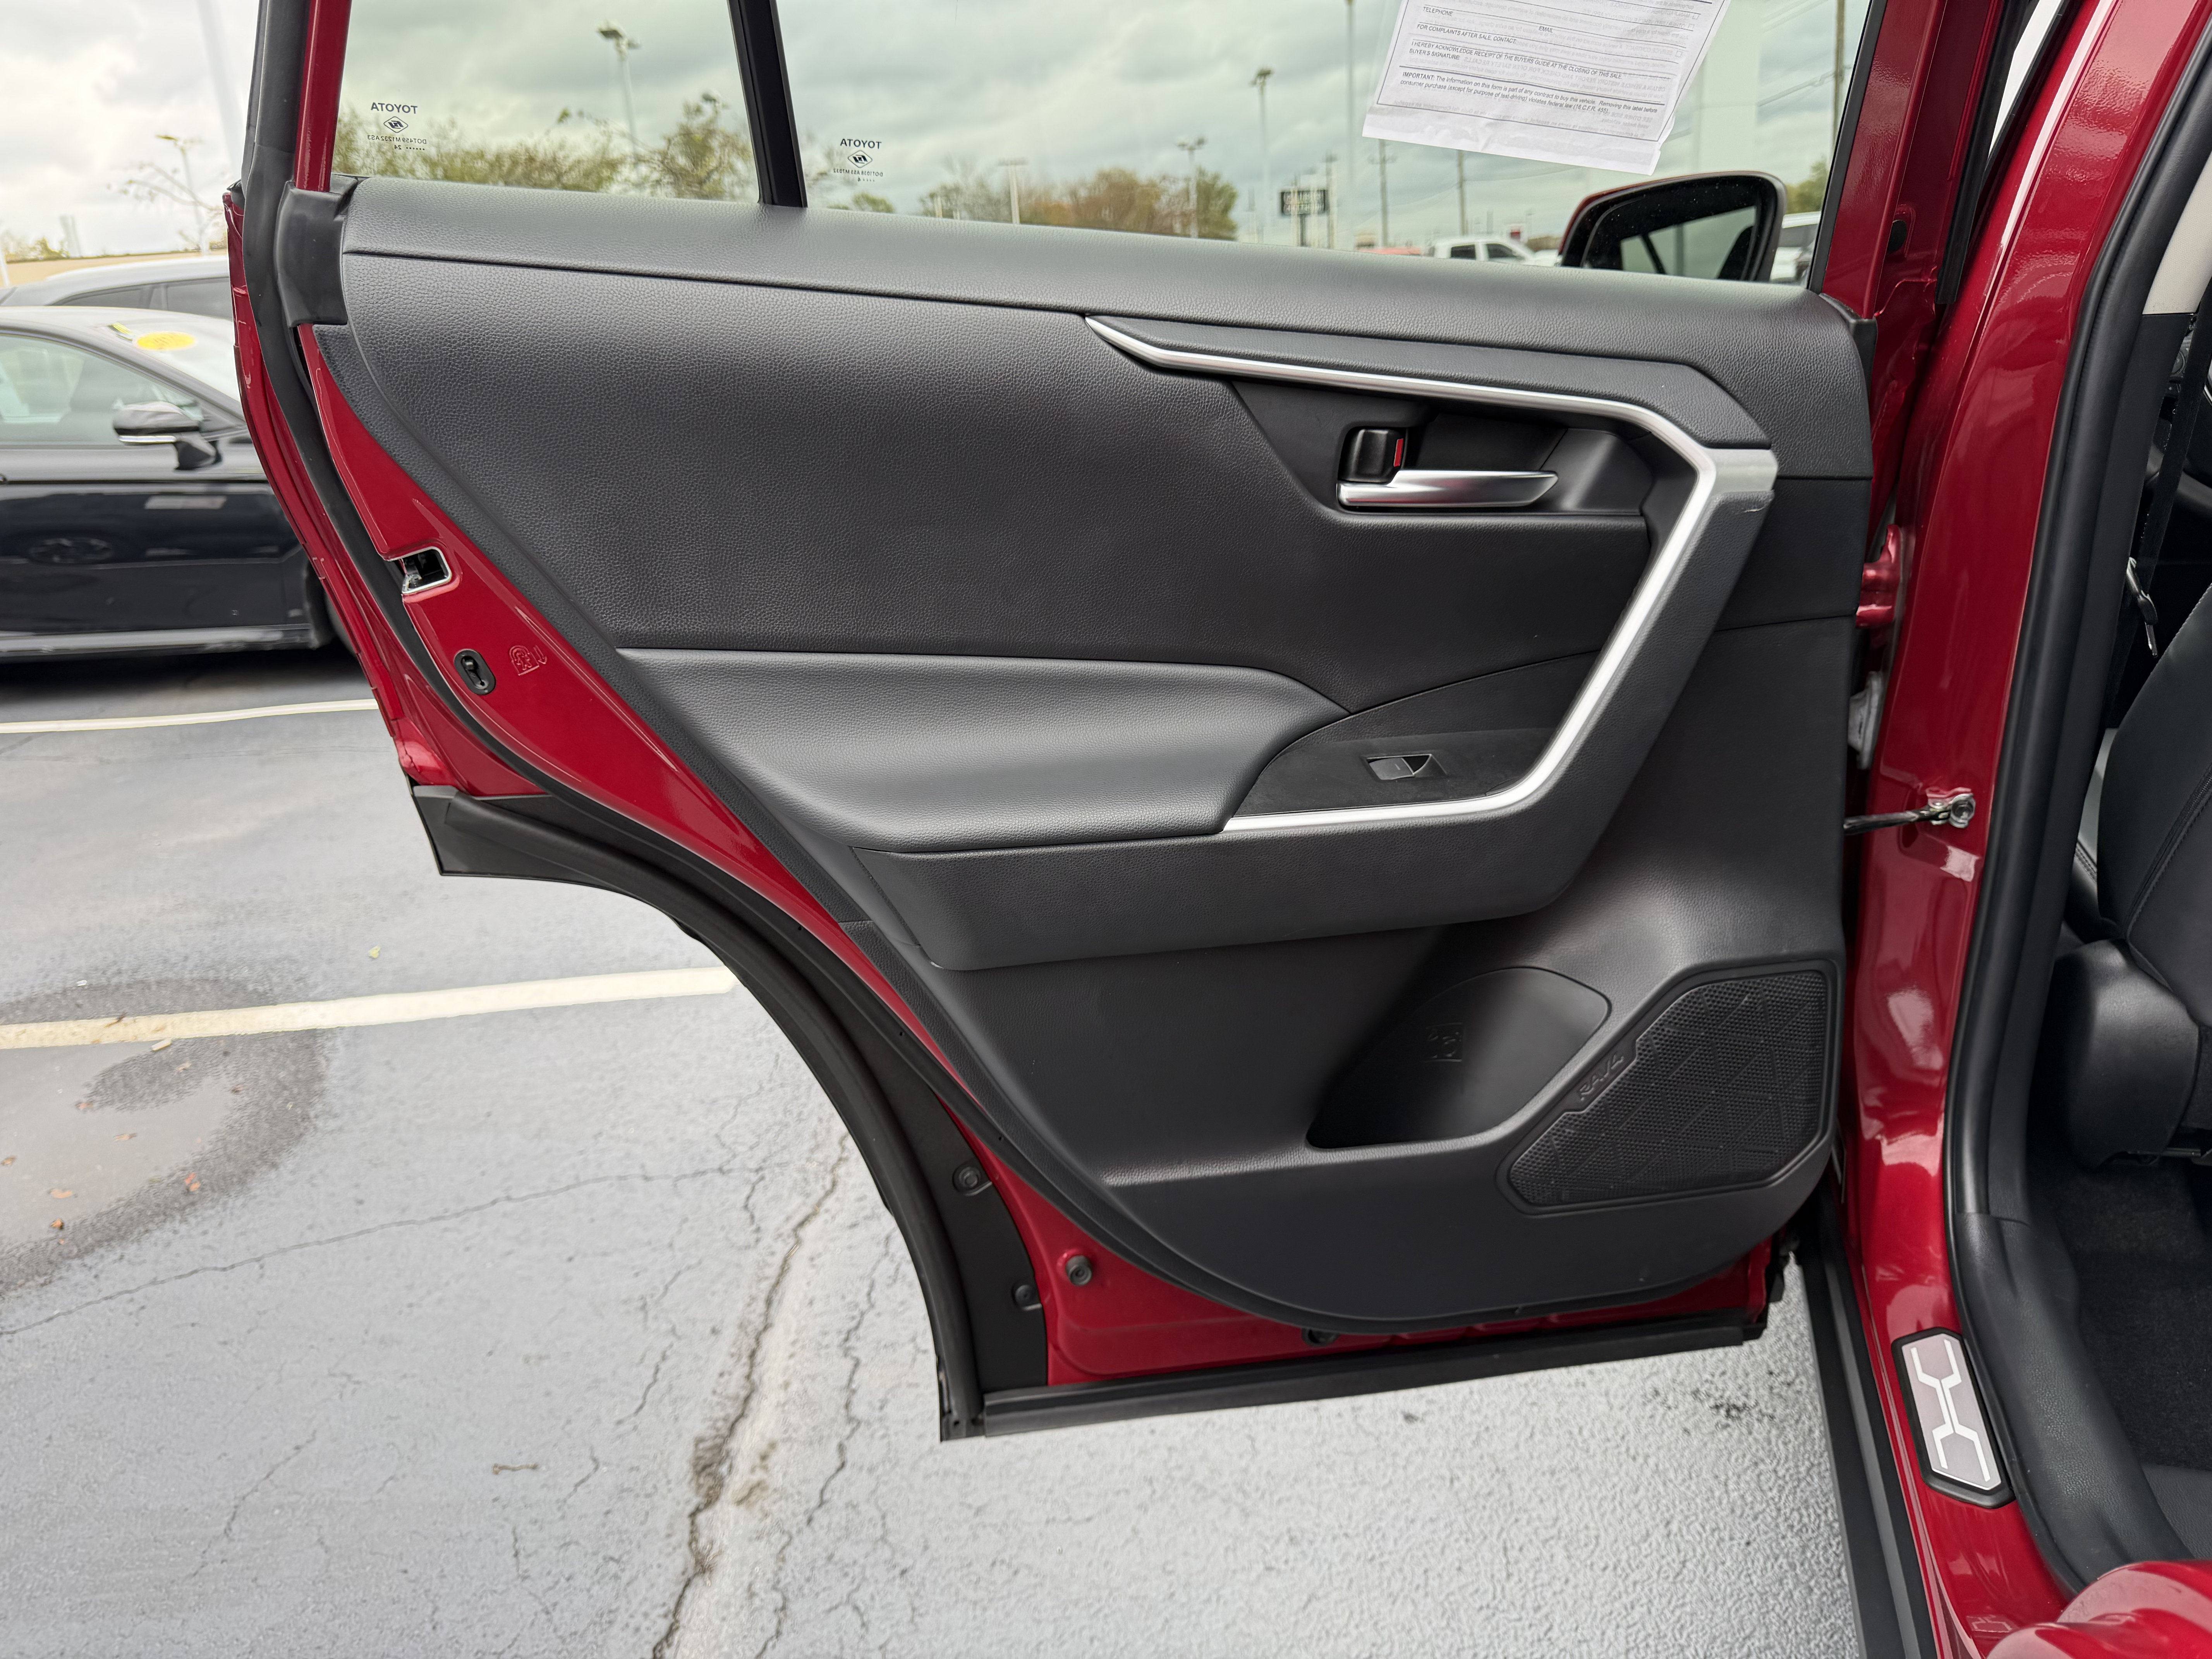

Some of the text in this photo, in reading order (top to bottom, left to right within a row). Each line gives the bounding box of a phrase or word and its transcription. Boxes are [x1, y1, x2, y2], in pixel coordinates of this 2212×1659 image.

[1423, 7, 1453, 16] TELEPHONE
[1429, 26, 1461, 36] COMPLAINTS
[1435, 45, 1473, 55] ACKNOWLEDGE
[1568, 66, 1590, 74] CLOSING
[1446, 77, 1472, 85] information
[1599, 101, 1622, 109] Removing
[1501, 93, 1527, 101] test-driving)
